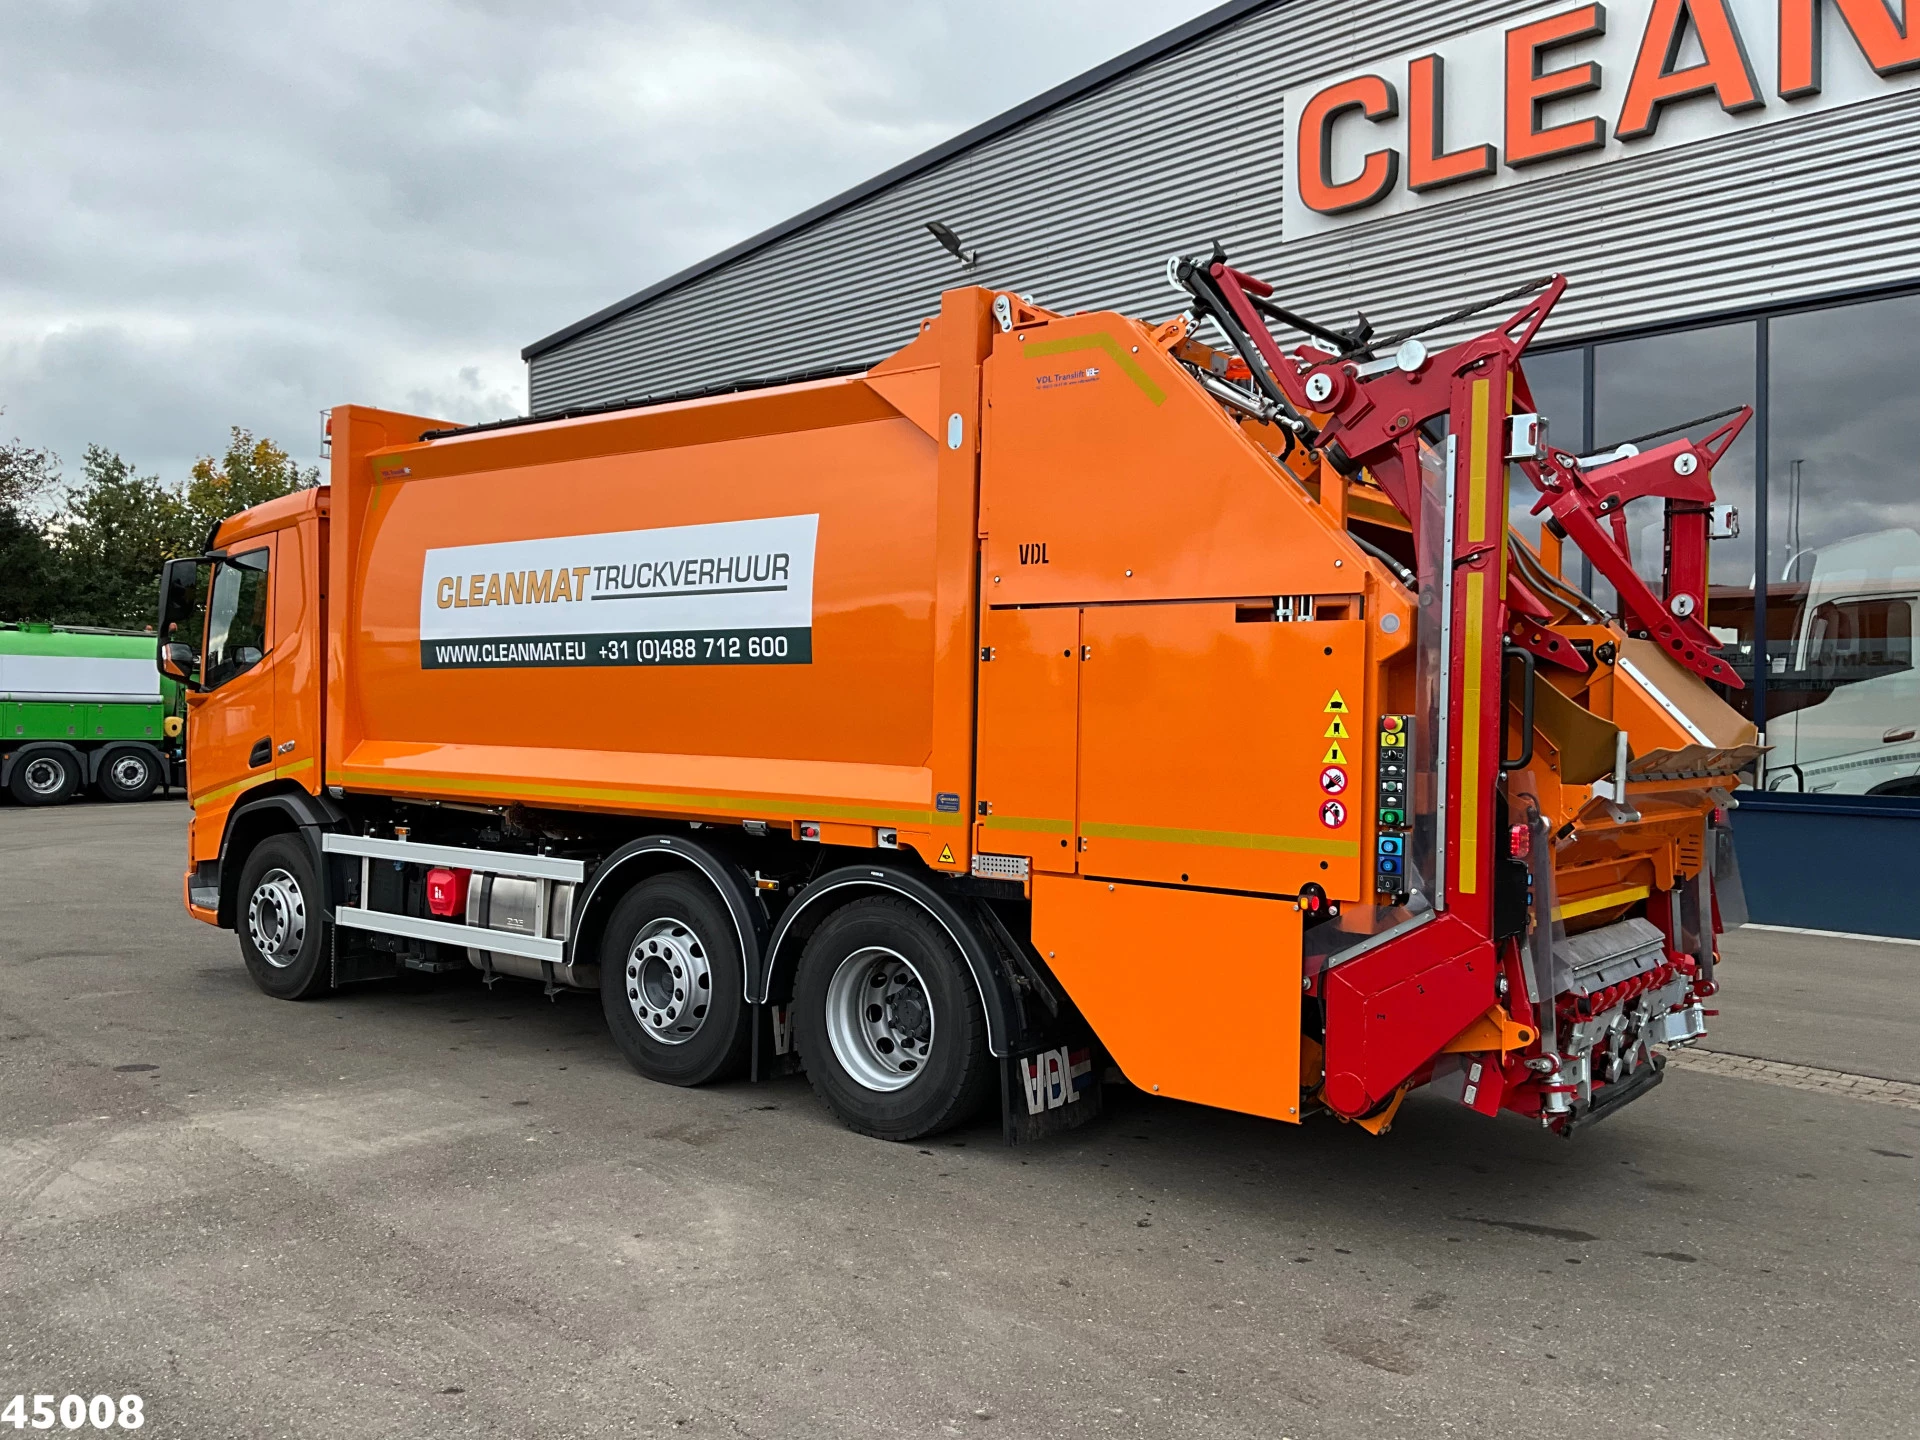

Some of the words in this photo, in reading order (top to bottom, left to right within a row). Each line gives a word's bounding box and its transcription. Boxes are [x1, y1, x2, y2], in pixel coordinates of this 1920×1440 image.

[1297, 0, 1920, 215] CLEAN
[1054, 370, 1085, 382] Translift
[1019, 542, 1049, 564] VDL
[437, 566, 591, 609] CLEANMAT
[593, 553, 789, 590] TRUCKVERHUUR
[436, 641, 586, 663] WWW.CLEANMAT.EU
[599, 640, 629, 660] +31
[637, 638, 696, 662] (0)488
[703, 637, 741, 658] 712
[748, 636, 788, 657] 600
[1020, 1046, 1080, 1116] VDL
